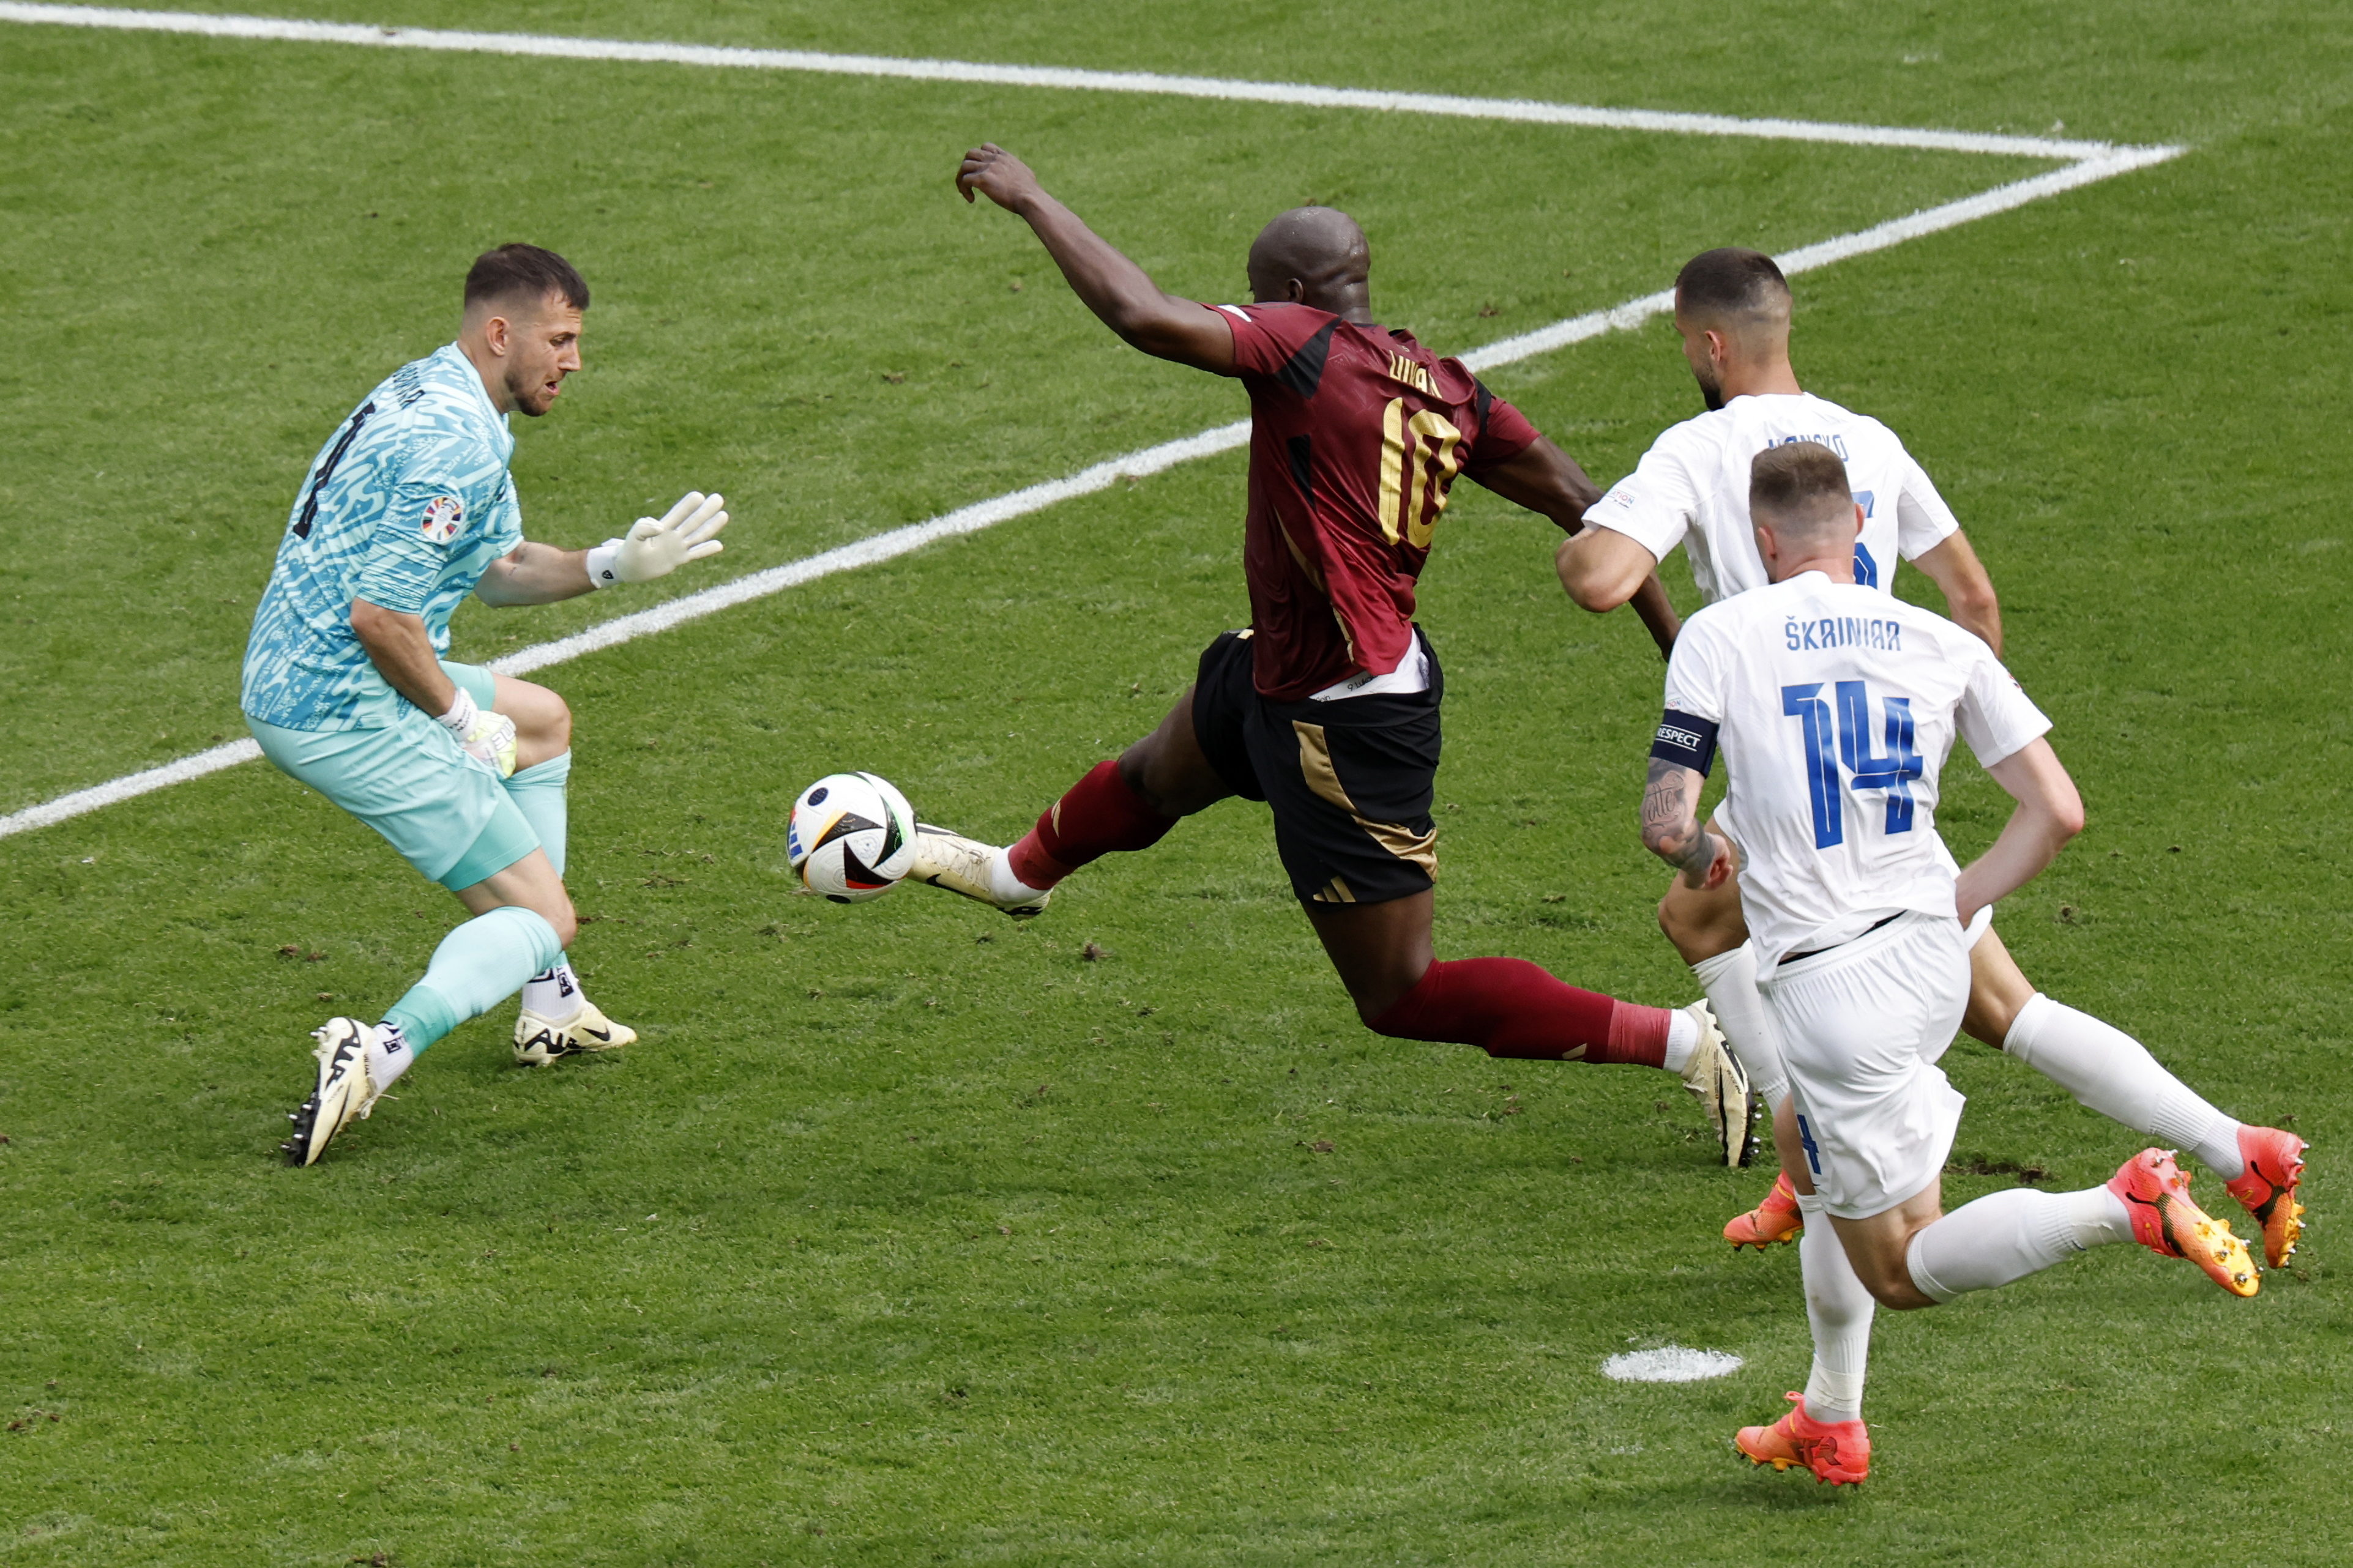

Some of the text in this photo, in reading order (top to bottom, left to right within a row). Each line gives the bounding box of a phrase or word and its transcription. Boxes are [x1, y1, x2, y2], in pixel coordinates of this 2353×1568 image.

[292, 401, 376, 540] 1
[1378, 397, 1461, 548] 10
[1785, 615, 1901, 652] ŠKRINIAR
[1657, 727, 1701, 747] RESPECT
[1781, 680, 1923, 849] 14
